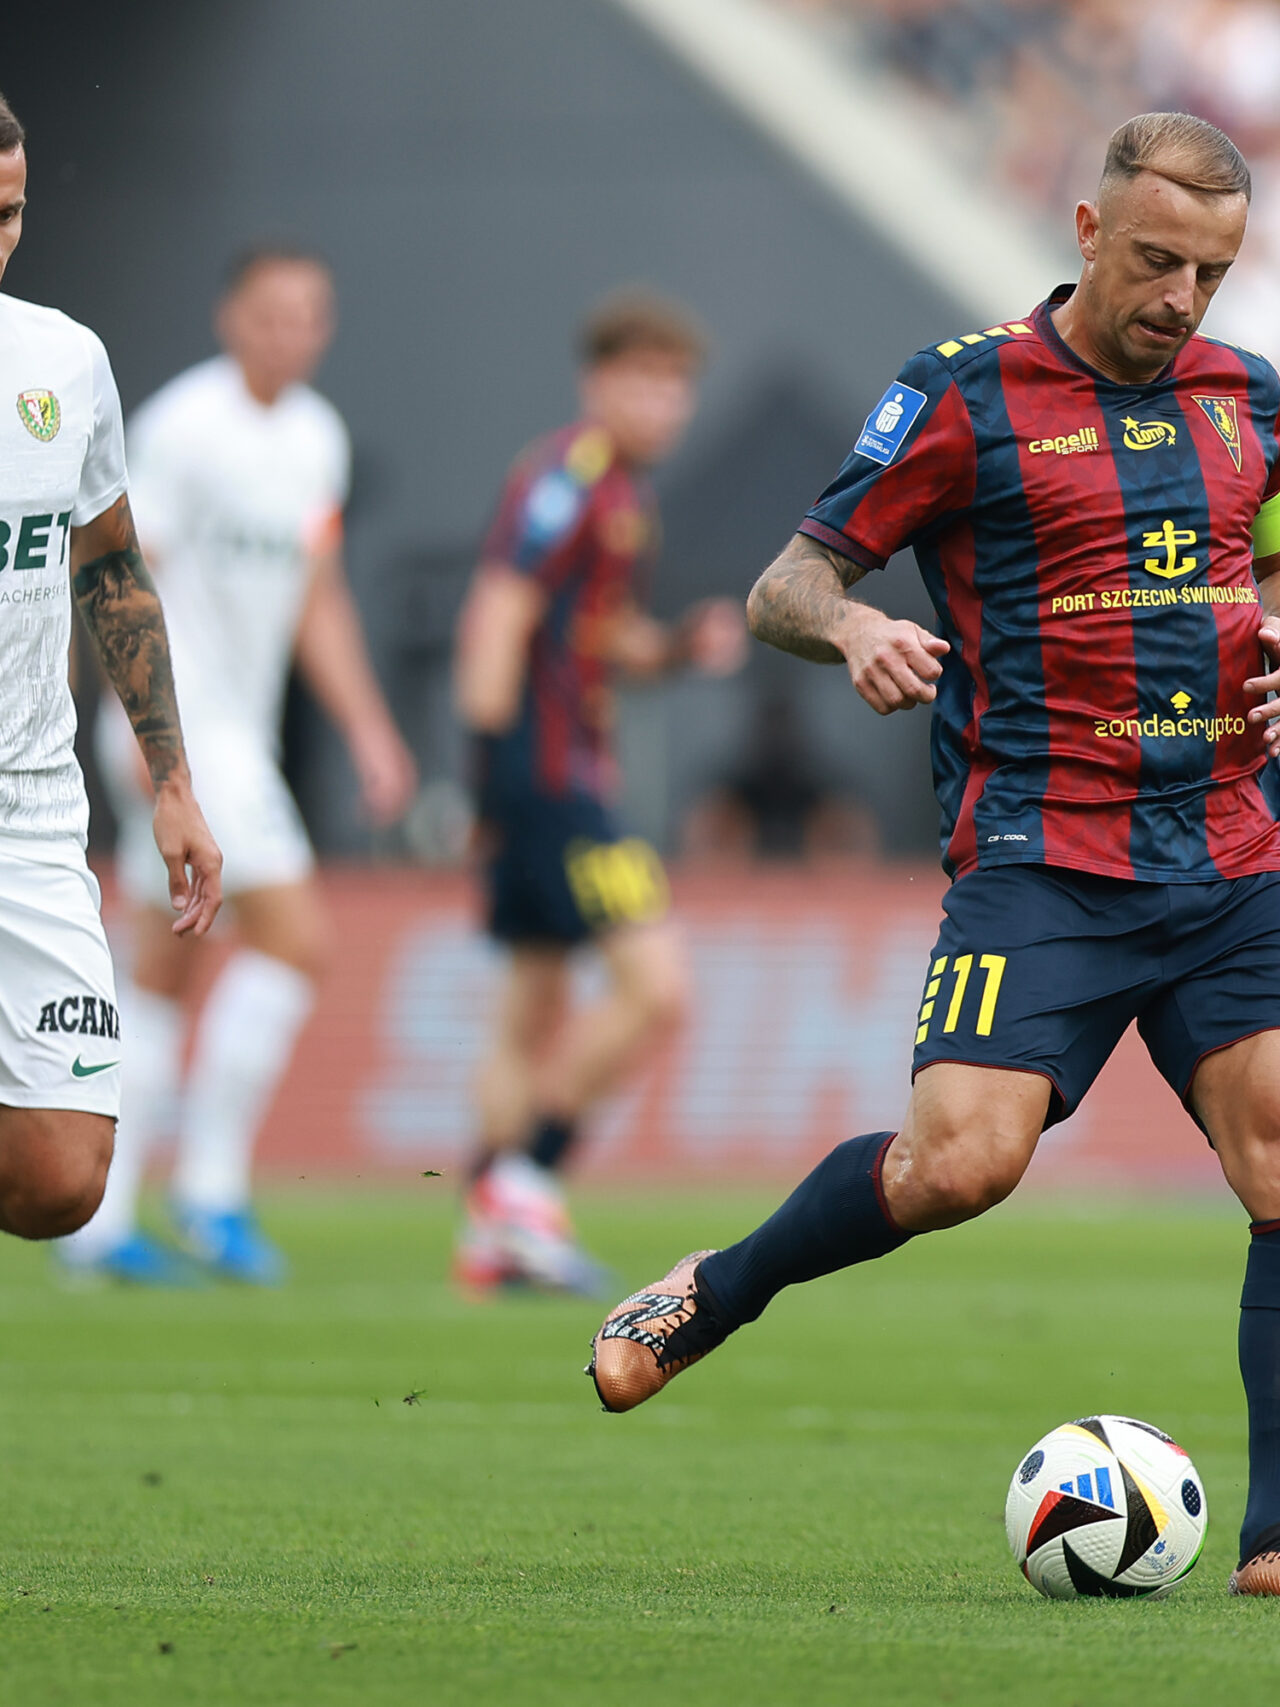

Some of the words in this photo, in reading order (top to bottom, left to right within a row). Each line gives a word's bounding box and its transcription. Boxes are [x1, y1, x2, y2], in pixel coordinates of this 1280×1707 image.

[1028, 427, 1098, 454] capelli
[1061, 443, 1099, 455] SPORT
[1131, 426, 1166, 444] LOTTO
[1051, 592, 1096, 614] PORT
[1101, 583, 1260, 609] SZCZECIN-ŚWINOUJŚCIE
[1094, 713, 1246, 742] zondacrypto
[943, 953, 1007, 1037] 11
